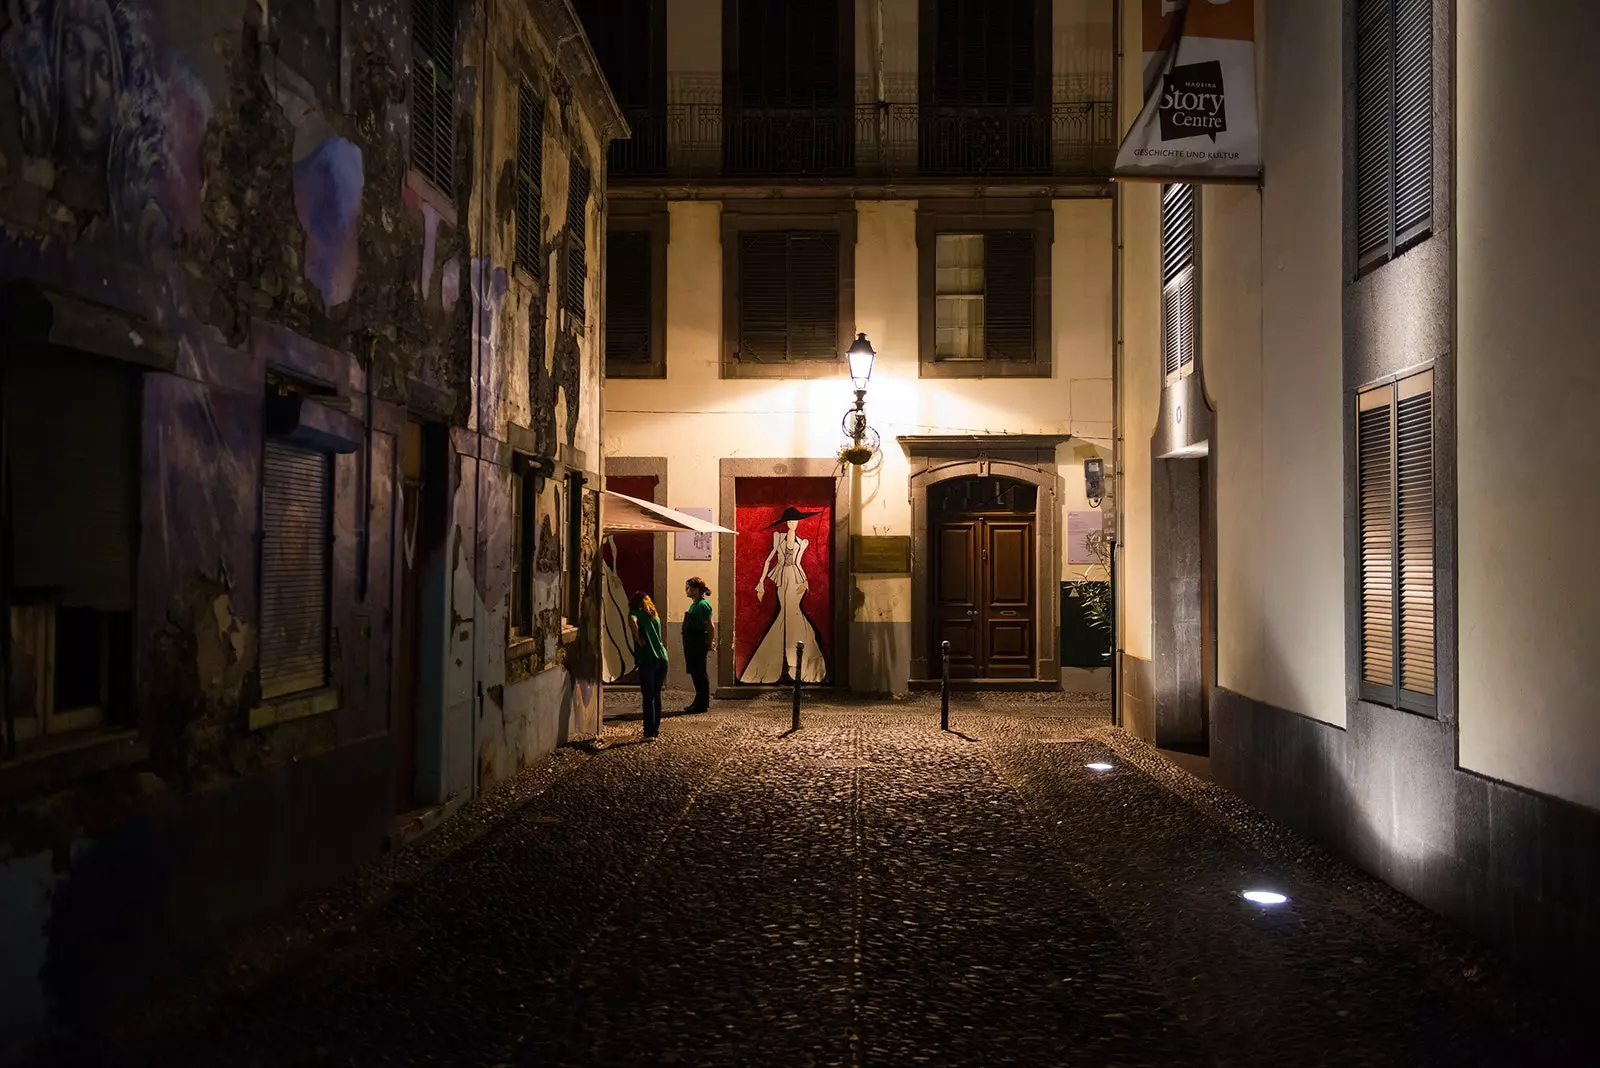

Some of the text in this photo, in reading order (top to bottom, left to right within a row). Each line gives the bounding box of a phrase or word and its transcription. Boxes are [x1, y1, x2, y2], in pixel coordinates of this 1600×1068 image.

[1185, 81, 1217, 89] MADEIRA
[1159, 84, 1225, 116] Story
[1172, 111, 1222, 128] Centre
[1134, 149, 1240, 159] GESCHICHTE UND KULTUR
